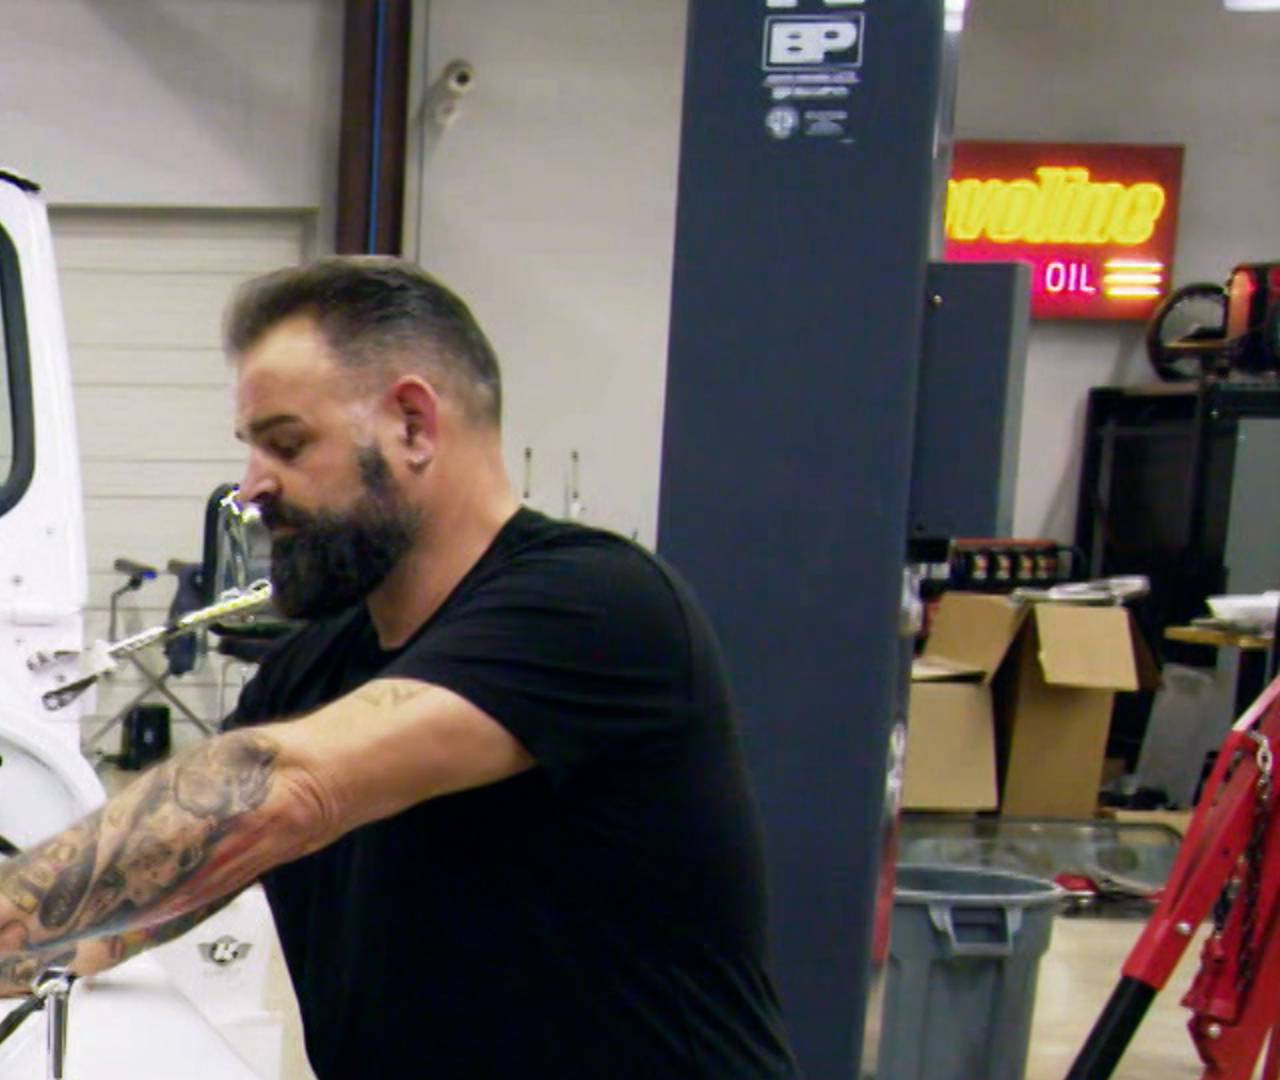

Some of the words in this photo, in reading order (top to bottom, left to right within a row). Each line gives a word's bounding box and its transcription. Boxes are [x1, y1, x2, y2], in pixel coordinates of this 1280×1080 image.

[769, 21, 857, 65] BP
[946, 166, 1164, 245] voline
[1045, 260, 1096, 293] OIL
